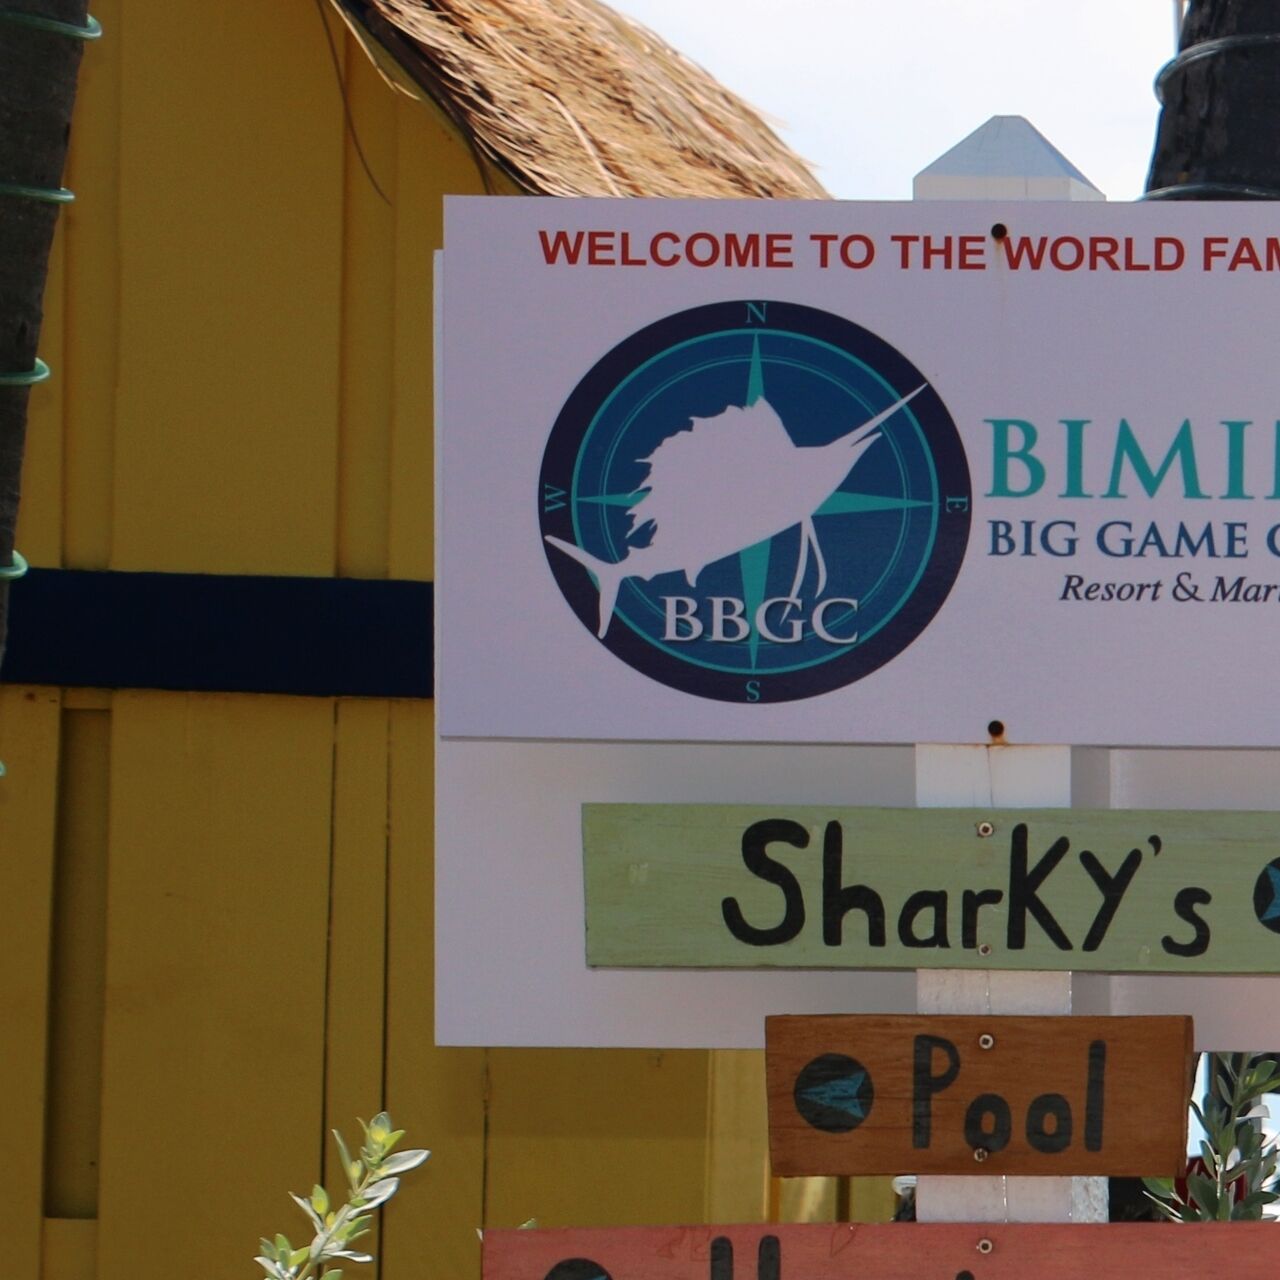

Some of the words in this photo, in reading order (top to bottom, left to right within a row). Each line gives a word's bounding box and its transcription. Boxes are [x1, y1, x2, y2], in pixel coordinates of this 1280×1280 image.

[539, 231, 793, 267] WELCOME
[810, 234, 875, 269] TO
[891, 235, 986, 270] THE
[1001, 235, 1184, 271] WORLD
[745, 302, 767, 323] N
[545, 483, 566, 511] W
[947, 495, 967, 513] E
[988, 520, 1079, 557] BIG
[1096, 521, 1248, 558] GAME
[1059, 575, 1163, 601] Resort
[1172, 572, 1205, 602] &
[660, 597, 859, 645] BBGC
[745, 681, 761, 703] S
[911, 1034, 1104, 1153] Pool
